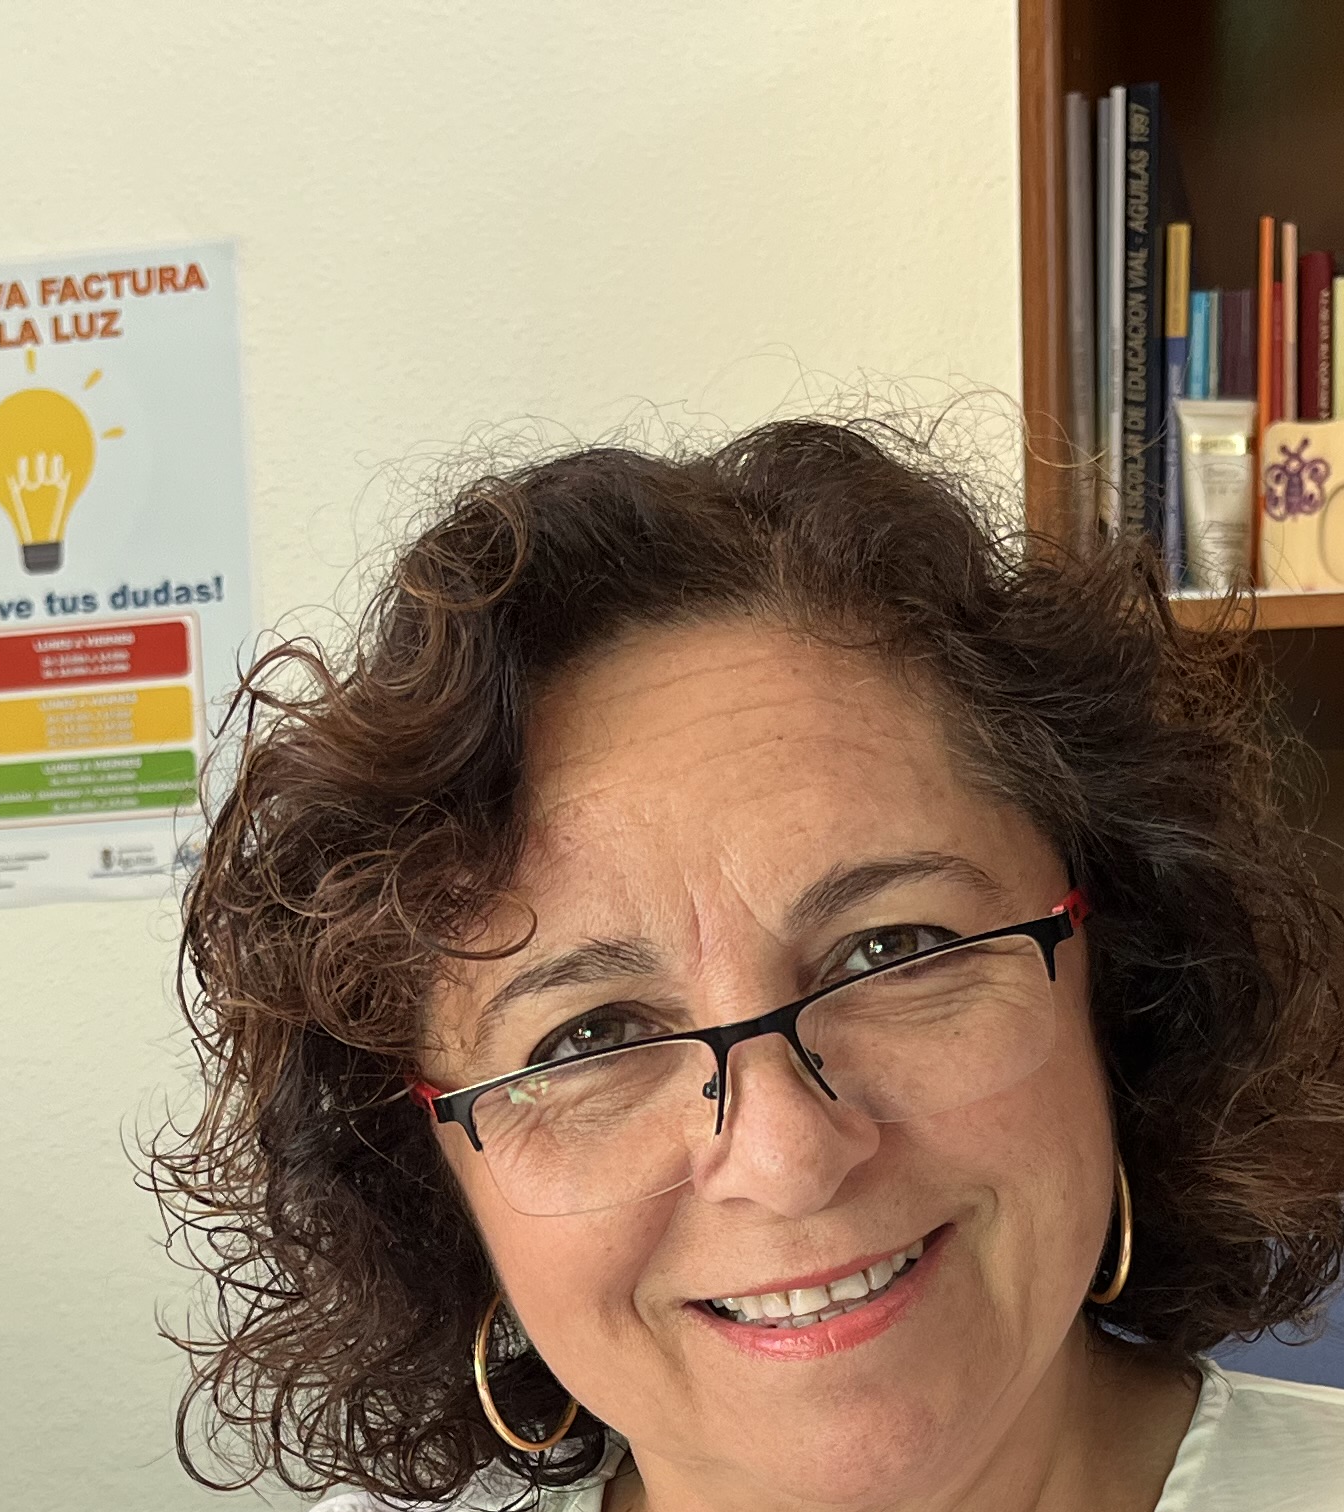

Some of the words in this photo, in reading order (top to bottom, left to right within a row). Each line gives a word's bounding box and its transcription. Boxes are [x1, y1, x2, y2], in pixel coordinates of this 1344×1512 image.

[38, 261, 209, 305] FACTURA
[51, 309, 123, 343] LUZ
[45, 593, 98, 615] tus
[108, 575, 224, 610] dudas!
